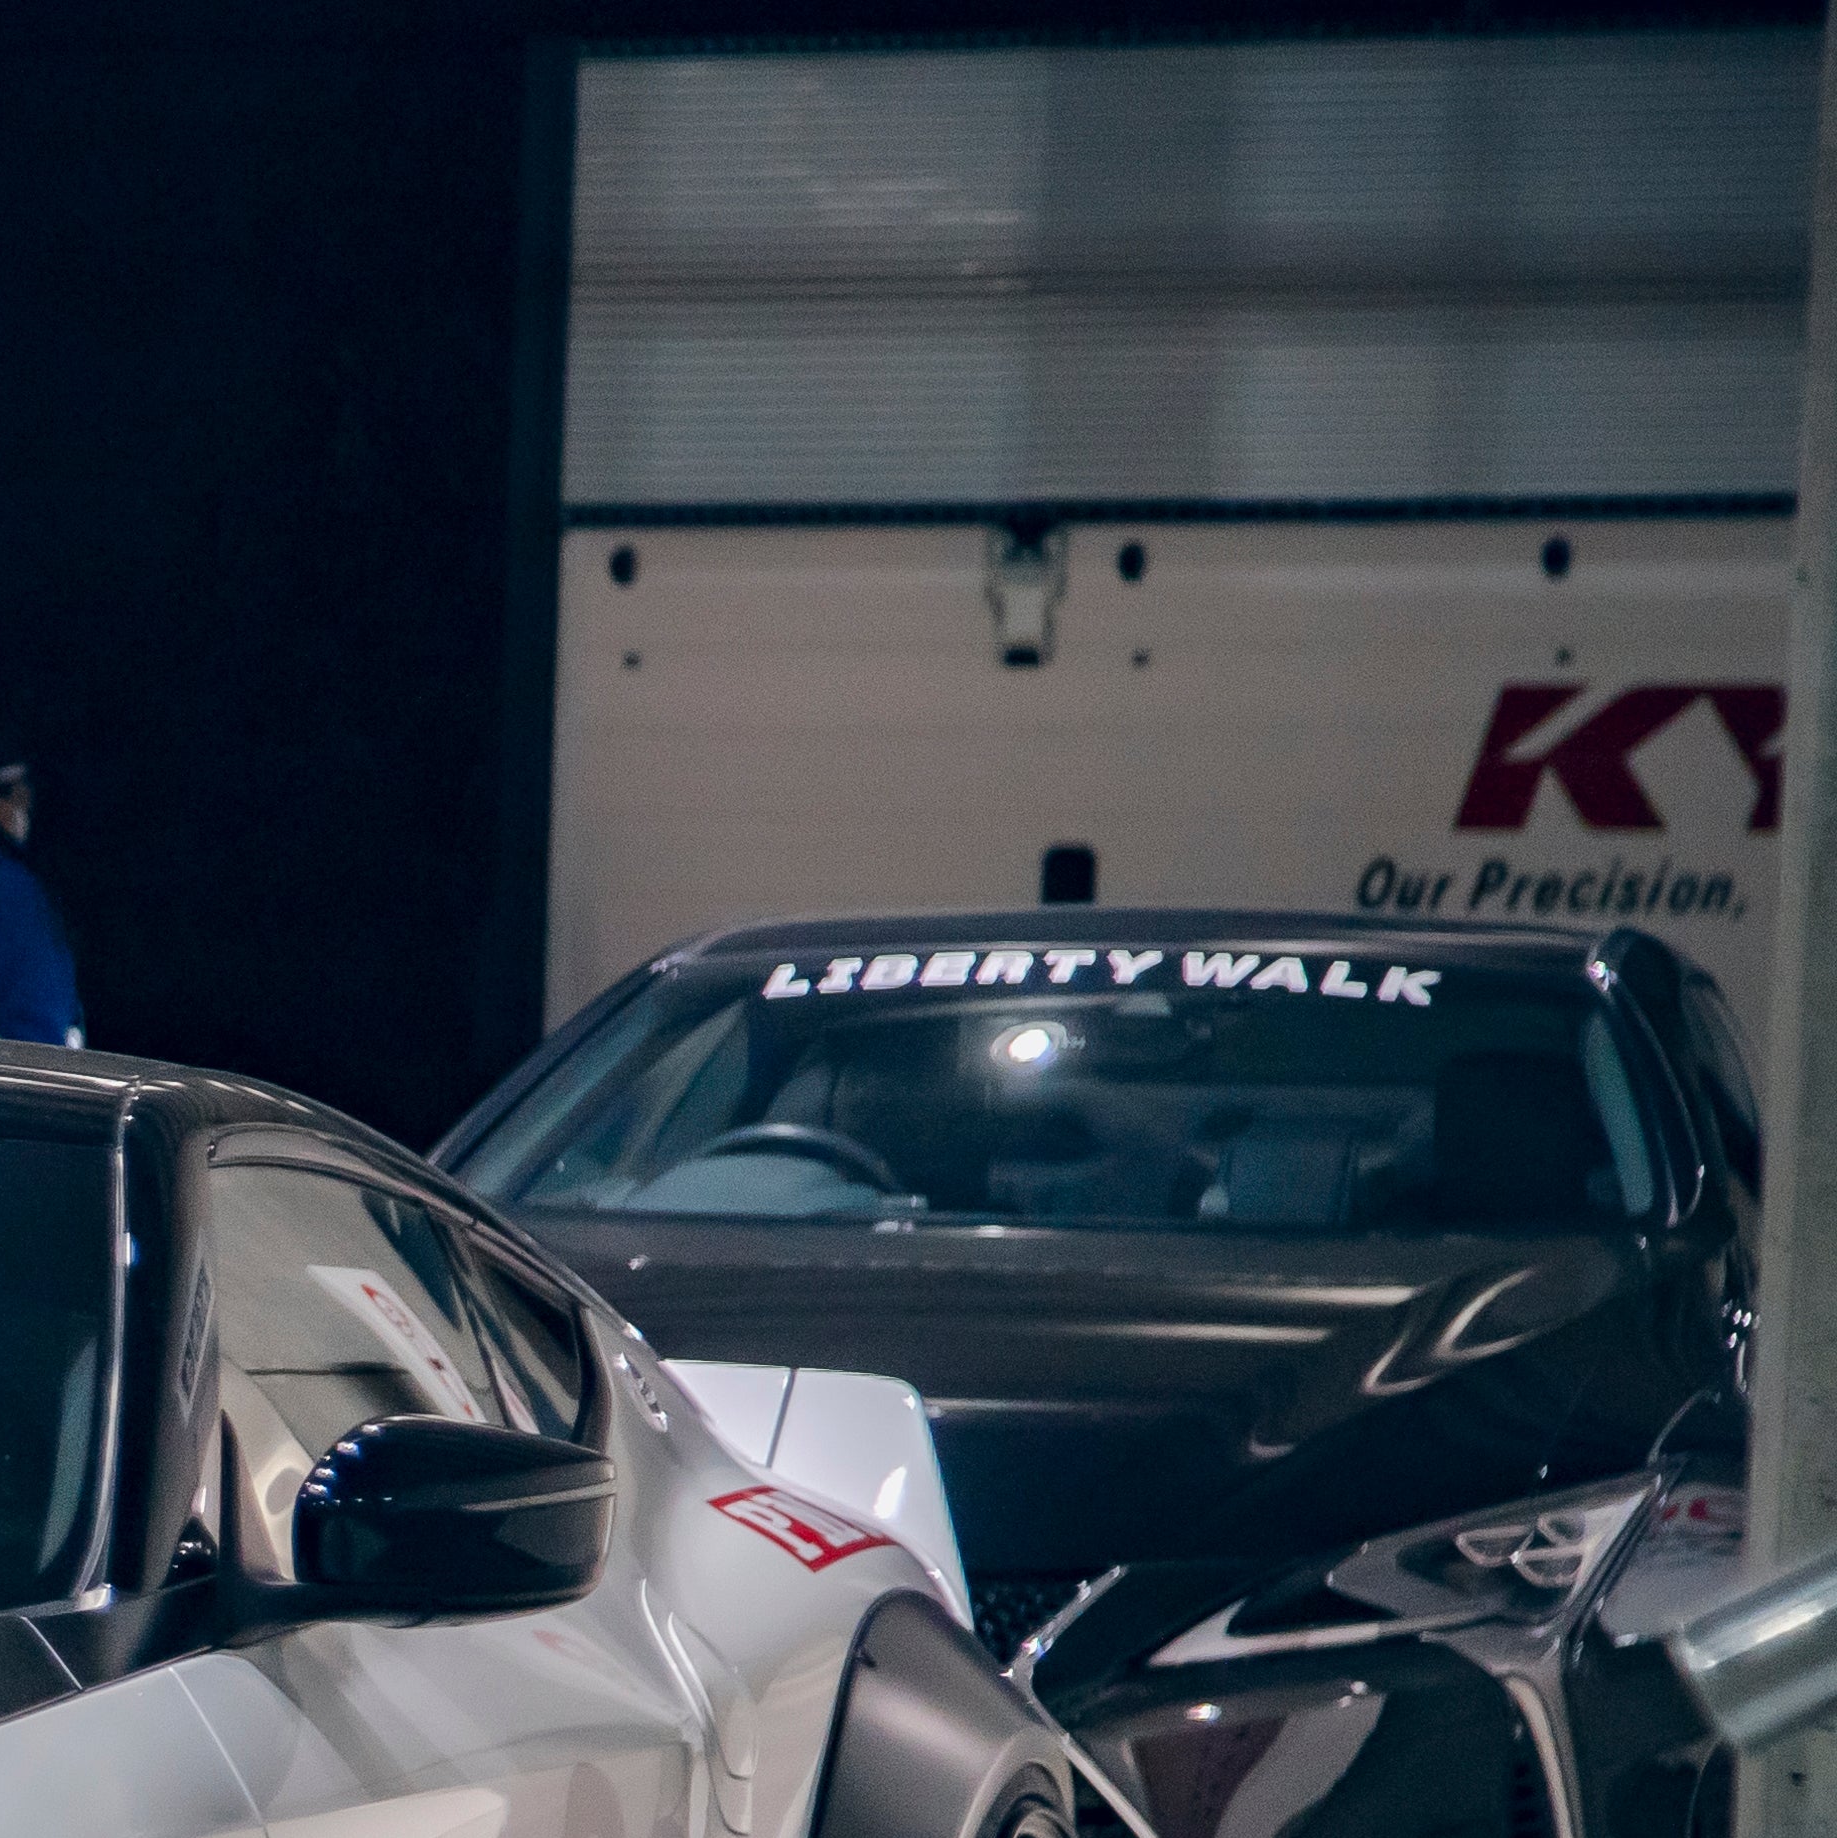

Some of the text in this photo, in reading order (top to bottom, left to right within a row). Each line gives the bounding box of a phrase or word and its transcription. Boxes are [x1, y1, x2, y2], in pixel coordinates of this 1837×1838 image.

[1355, 854, 1745, 920] Our Precision,
[761, 948, 1443, 1006] LIBERTY WALK
